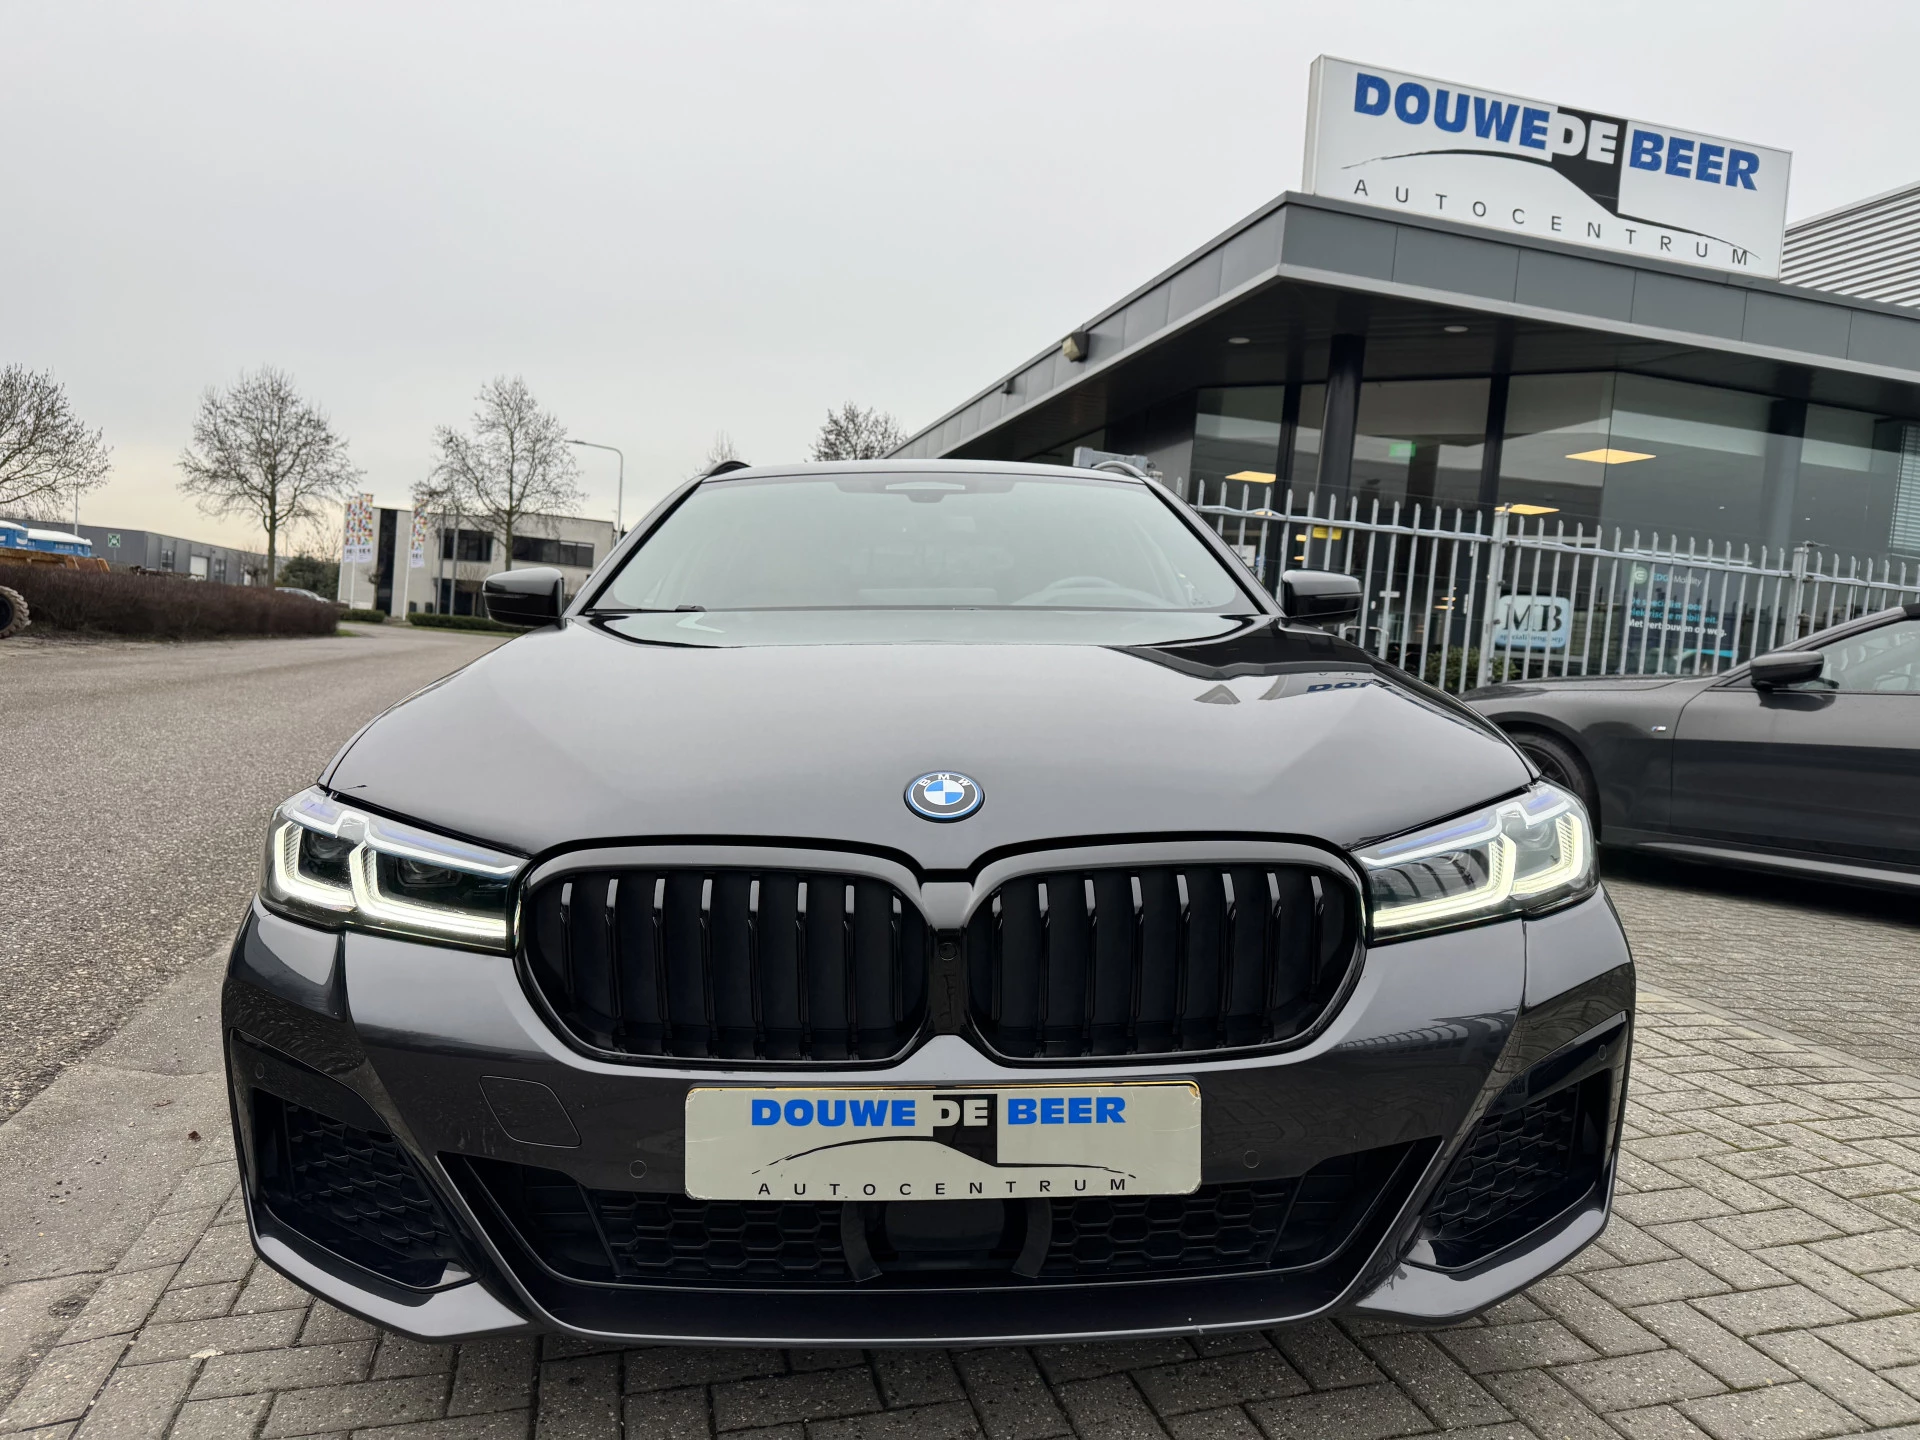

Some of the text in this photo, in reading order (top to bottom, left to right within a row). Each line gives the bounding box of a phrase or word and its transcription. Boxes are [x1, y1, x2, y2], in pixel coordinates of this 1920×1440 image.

[1354, 71, 1761, 192] DOUWE DE BEER
[1353, 178, 1749, 267] AUTOCENTRUM
[1629, 606, 1674, 619] elekrisce
[1641, 597, 1682, 609] secilist
[1686, 603, 1704, 612] oor
[1502, 603, 1563, 632] MB
[1645, 620, 1693, 633] ertouwen
[918, 773, 971, 787] BMW
[751, 1095, 1127, 1128] DOUWE DE BEER
[757, 1177, 1127, 1197] AUTOCENTRUM
